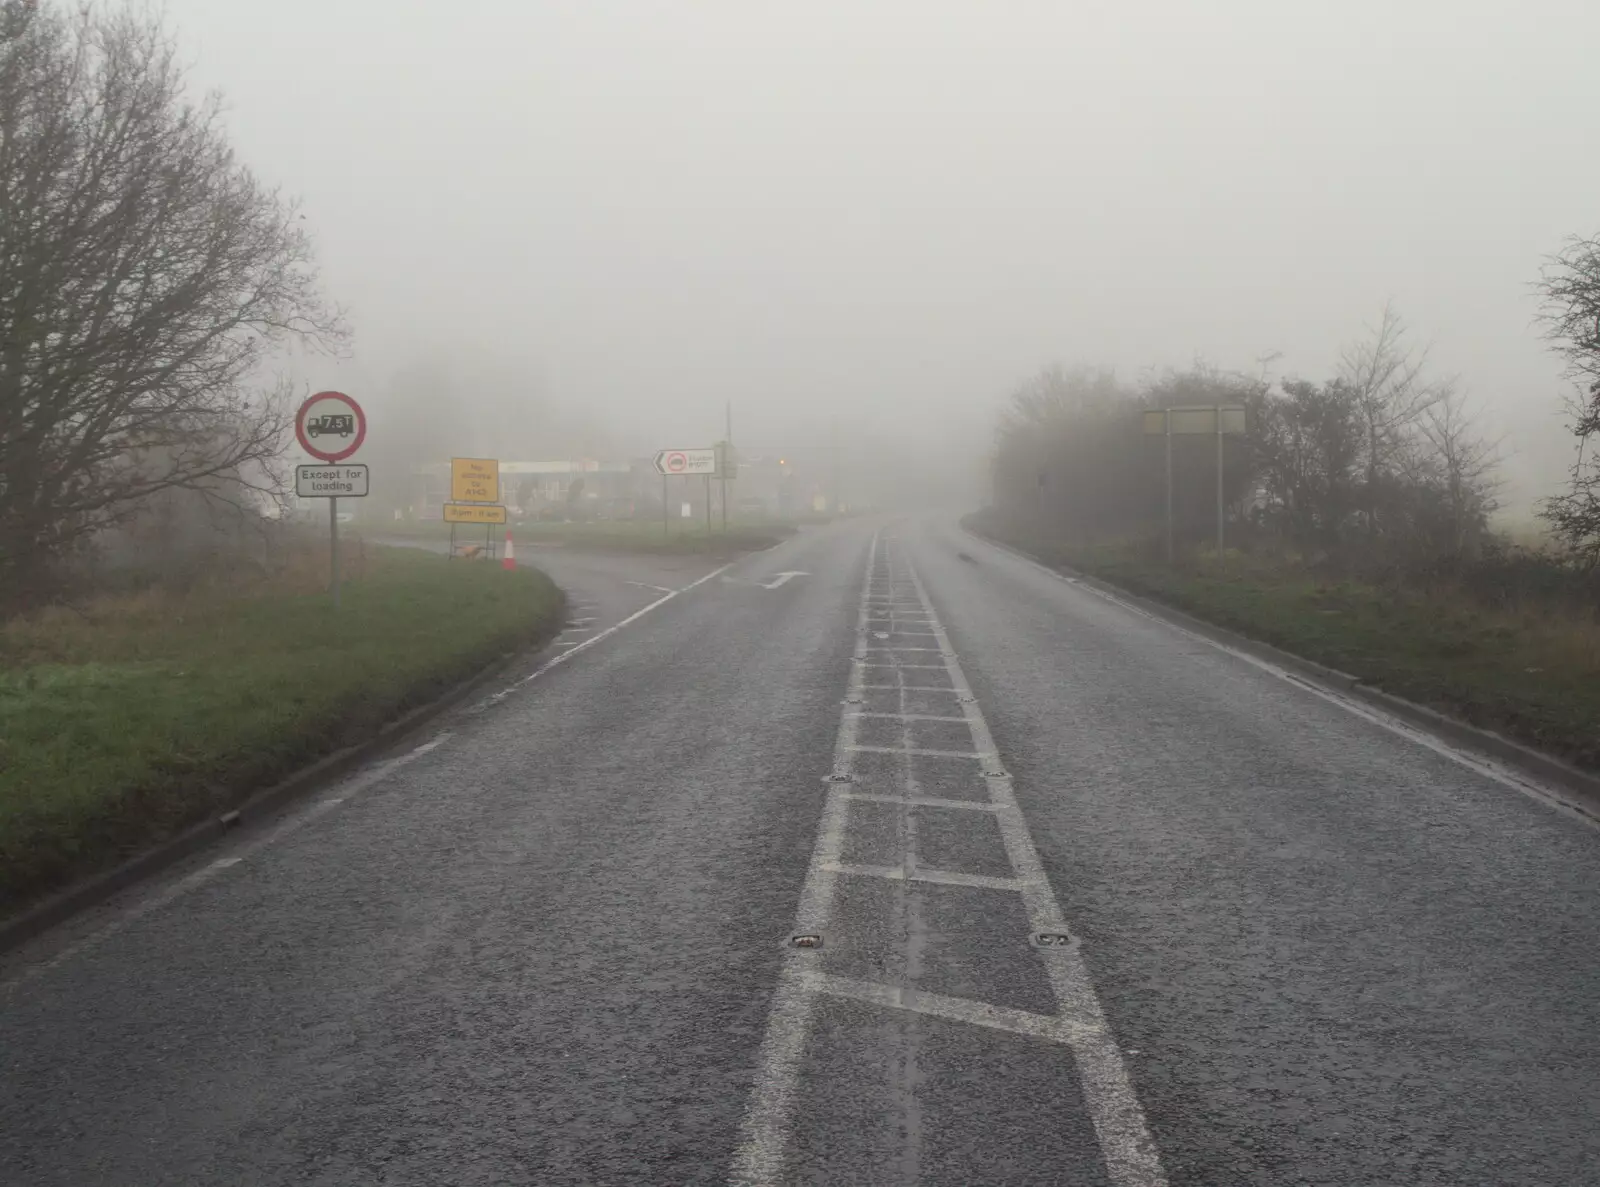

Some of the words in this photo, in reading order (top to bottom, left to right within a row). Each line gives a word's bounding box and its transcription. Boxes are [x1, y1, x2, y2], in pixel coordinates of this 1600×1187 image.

[324, 416, 351, 428] 7.5T
[302, 469, 340, 480] Except
[346, 469, 362, 479] for
[312, 482, 353, 492] loading
